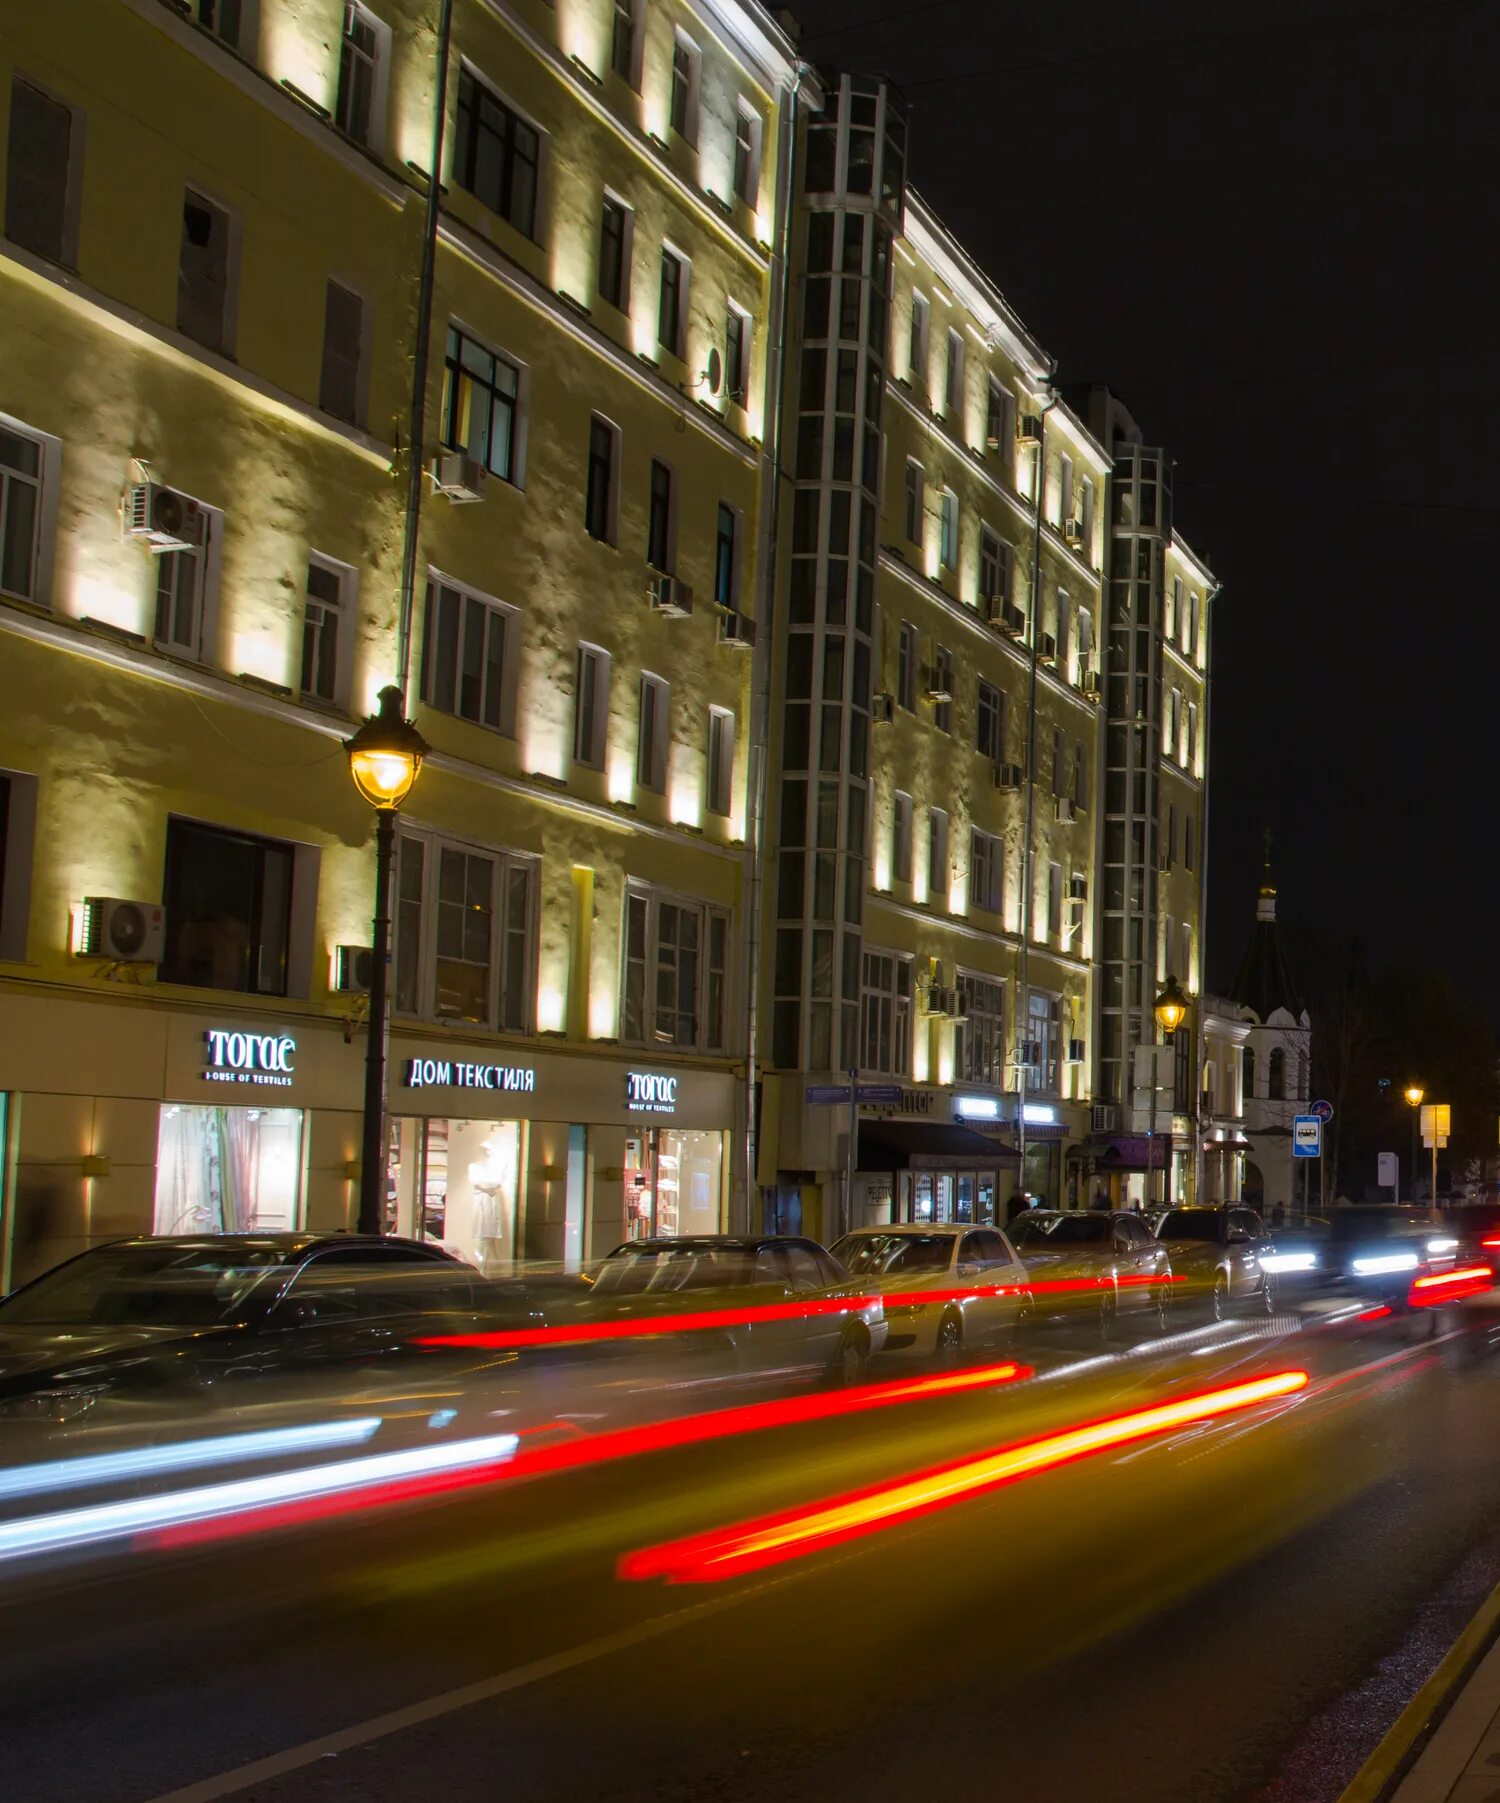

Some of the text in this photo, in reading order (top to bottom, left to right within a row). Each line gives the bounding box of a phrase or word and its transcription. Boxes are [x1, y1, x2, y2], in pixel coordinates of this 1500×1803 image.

[238, 1074, 250, 1082] OF
[410, 1059, 534, 1092] ДОМ ТЕКСТИЛЯ
